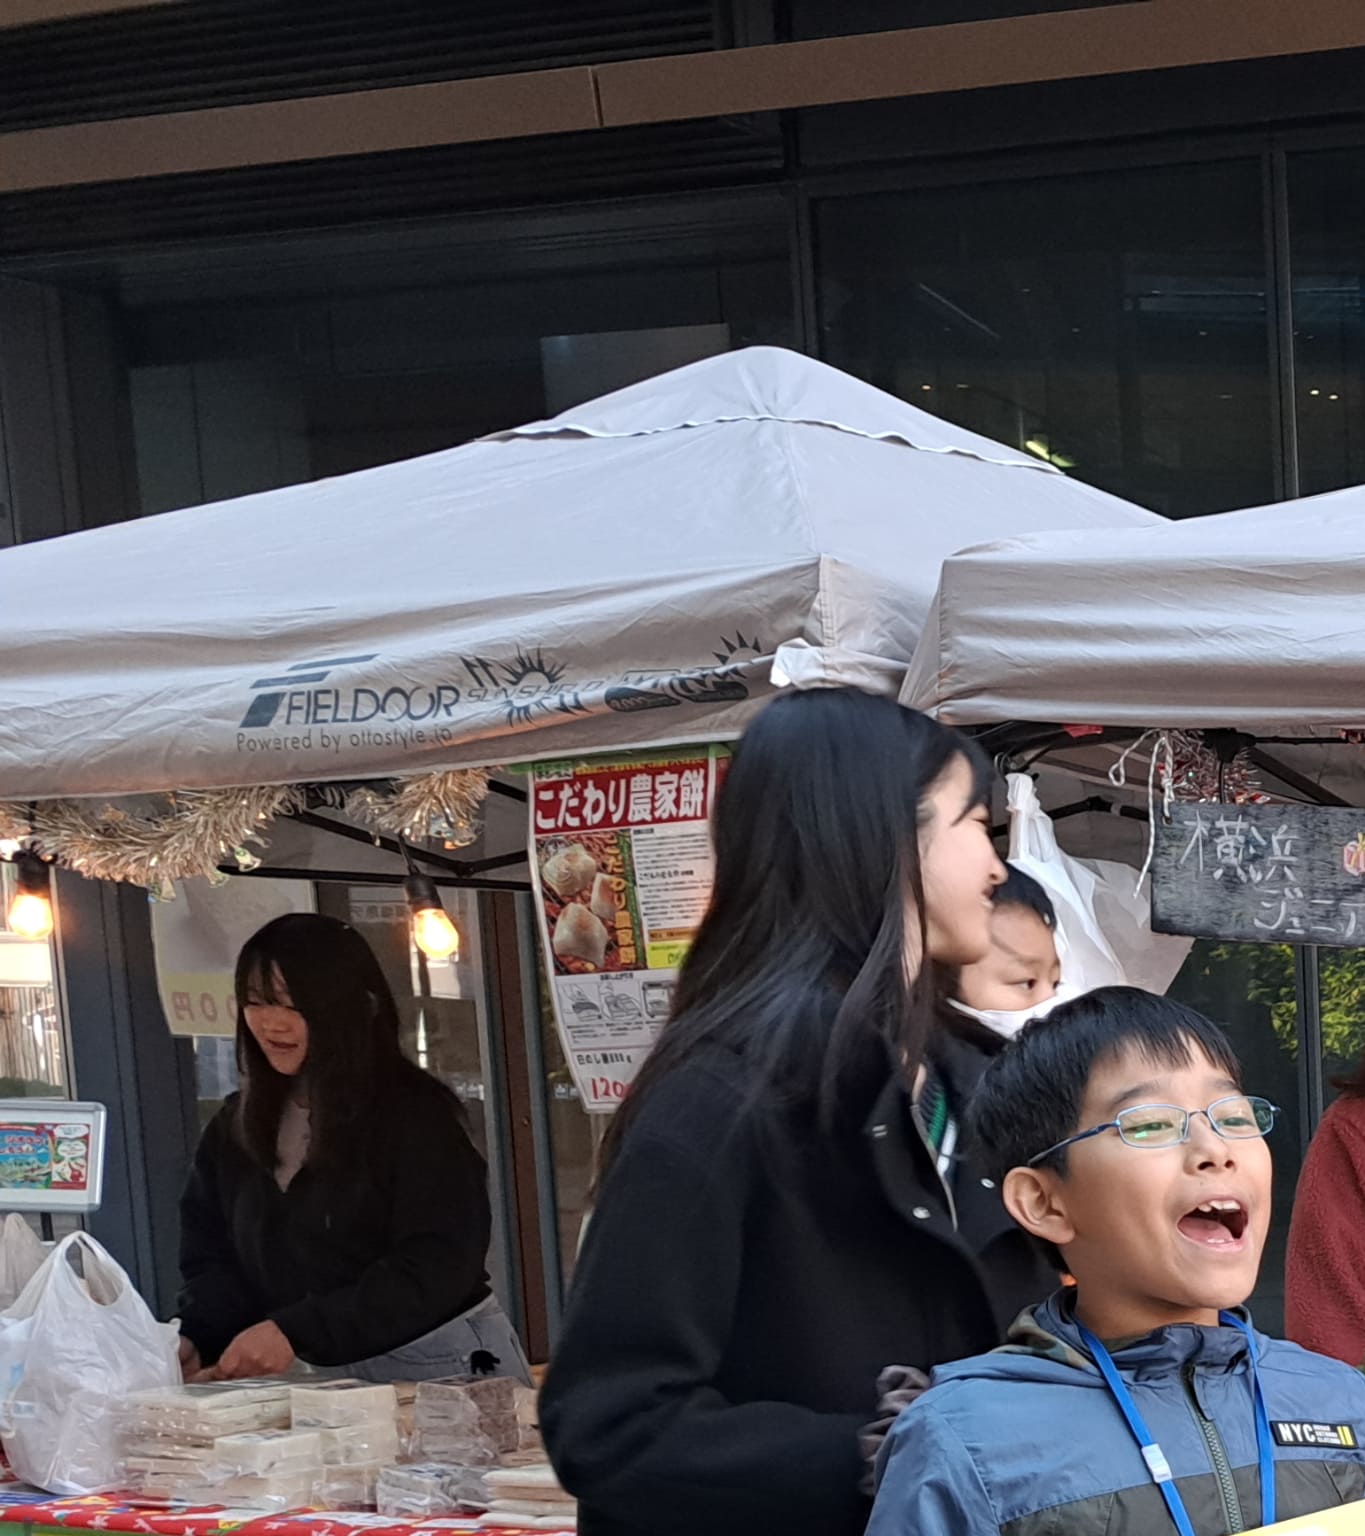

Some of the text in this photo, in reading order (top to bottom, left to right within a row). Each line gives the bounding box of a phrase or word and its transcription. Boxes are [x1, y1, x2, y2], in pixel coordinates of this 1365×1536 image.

[286, 685, 461, 725] FIELDOOR
[237, 727, 312, 754] Powered
[321, 726, 341, 751] by
[536, 768, 706, 830] こだわり農家餅
[1180, 812, 1298, 883] 横浜
[1278, 1423, 1316, 1442] NYC
